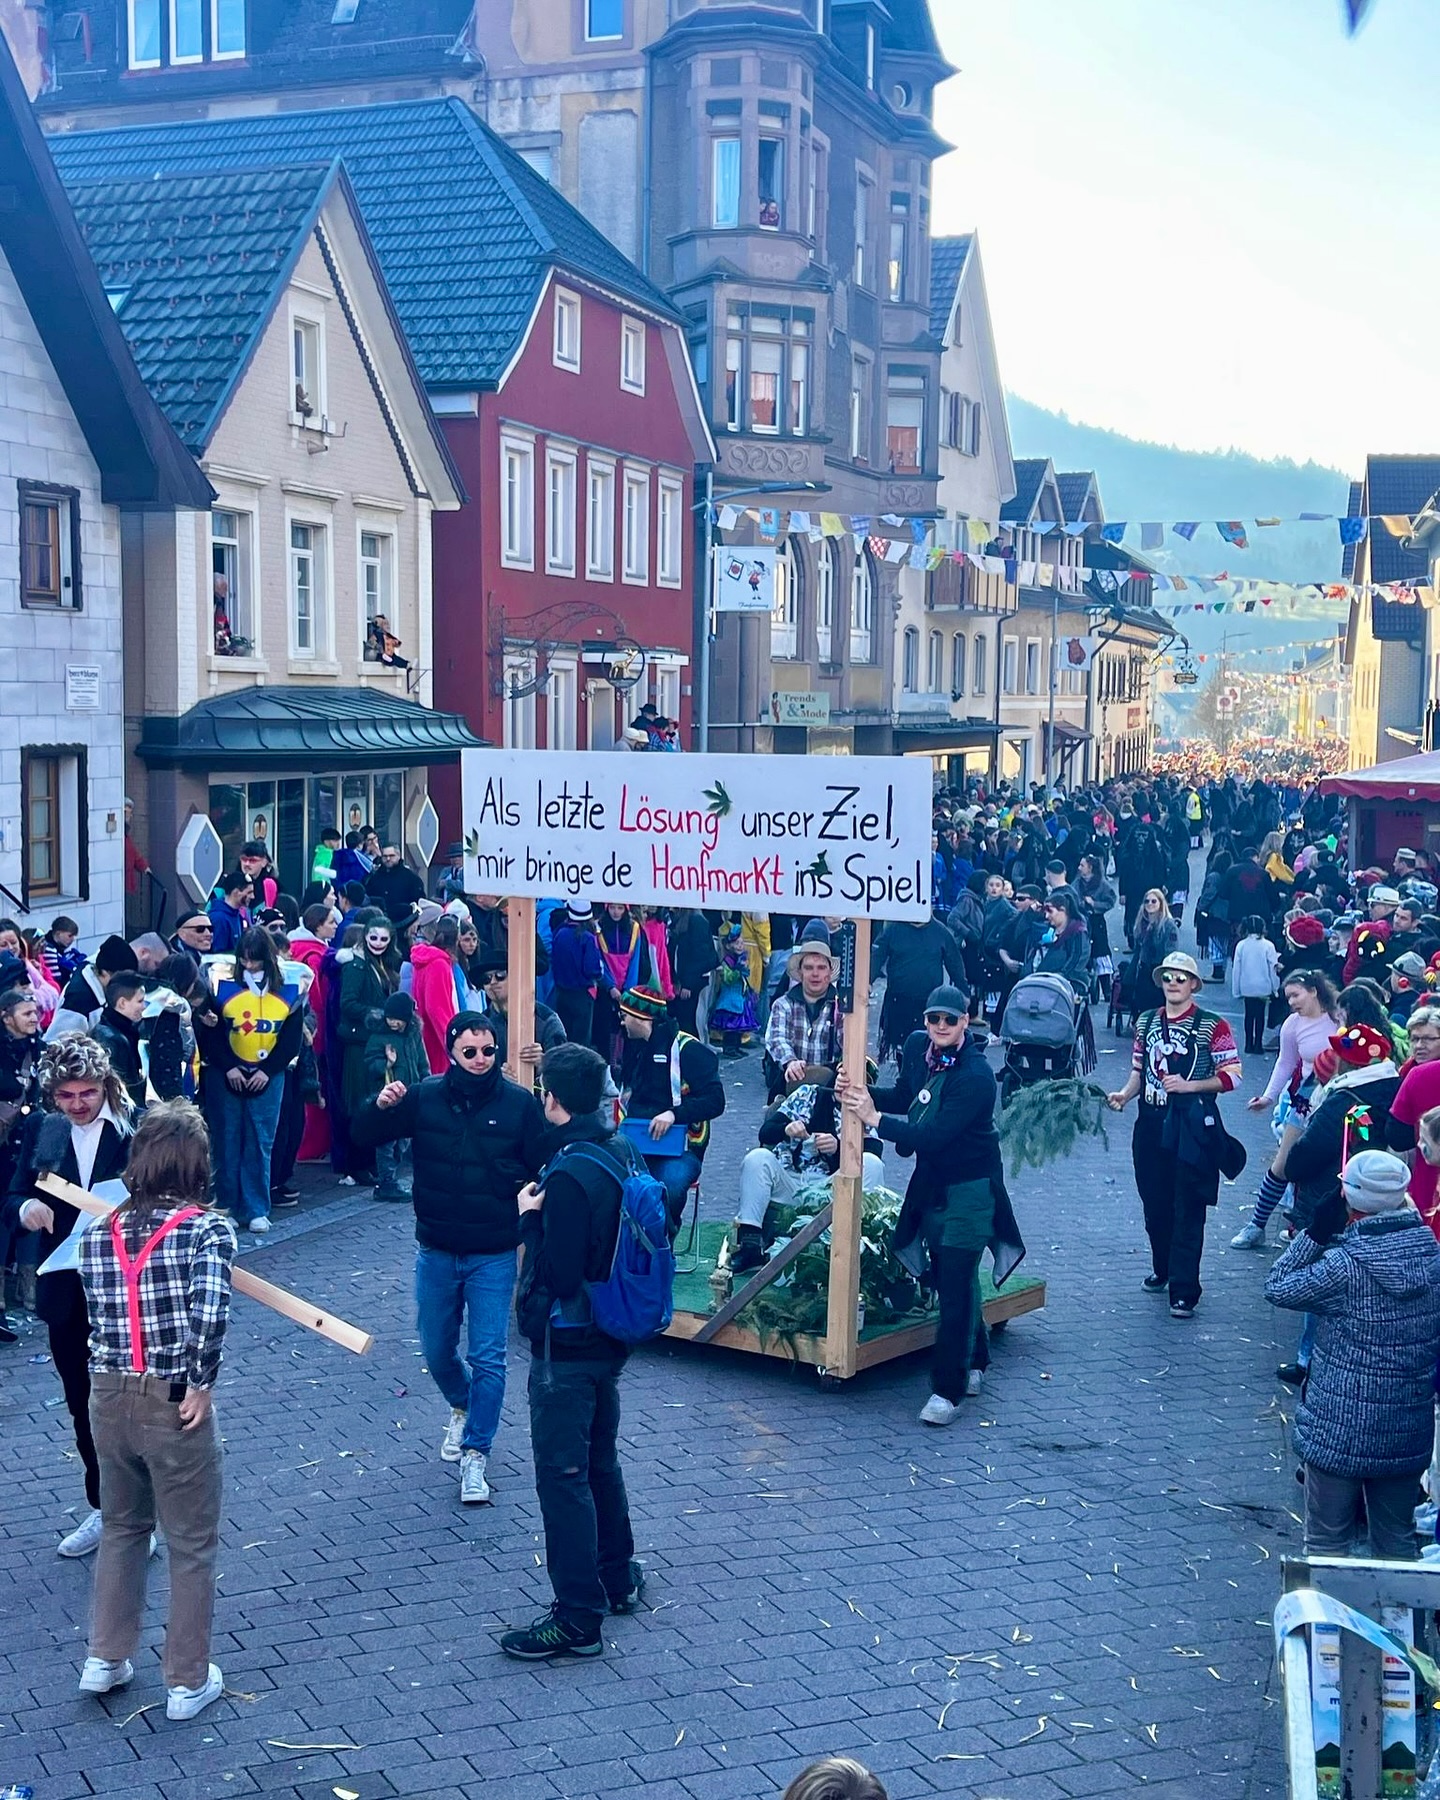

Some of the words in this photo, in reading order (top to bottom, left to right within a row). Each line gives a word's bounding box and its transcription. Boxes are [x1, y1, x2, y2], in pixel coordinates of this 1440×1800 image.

[783, 694, 816, 703] Trends
[786, 703, 800, 717] &
[800, 709, 827, 718] Mode
[480, 777, 521, 827] Als
[537, 780, 605, 831] letzte
[619, 784, 720, 850] Lösung
[741, 811, 814, 838] unser
[818, 784, 900, 849] Ziel,
[477, 847, 515, 879] mir
[526, 846, 594, 895] bringe
[602, 851, 633, 888] de
[795, 859, 833, 899] ins
[840, 852, 927, 913] Spiel.
